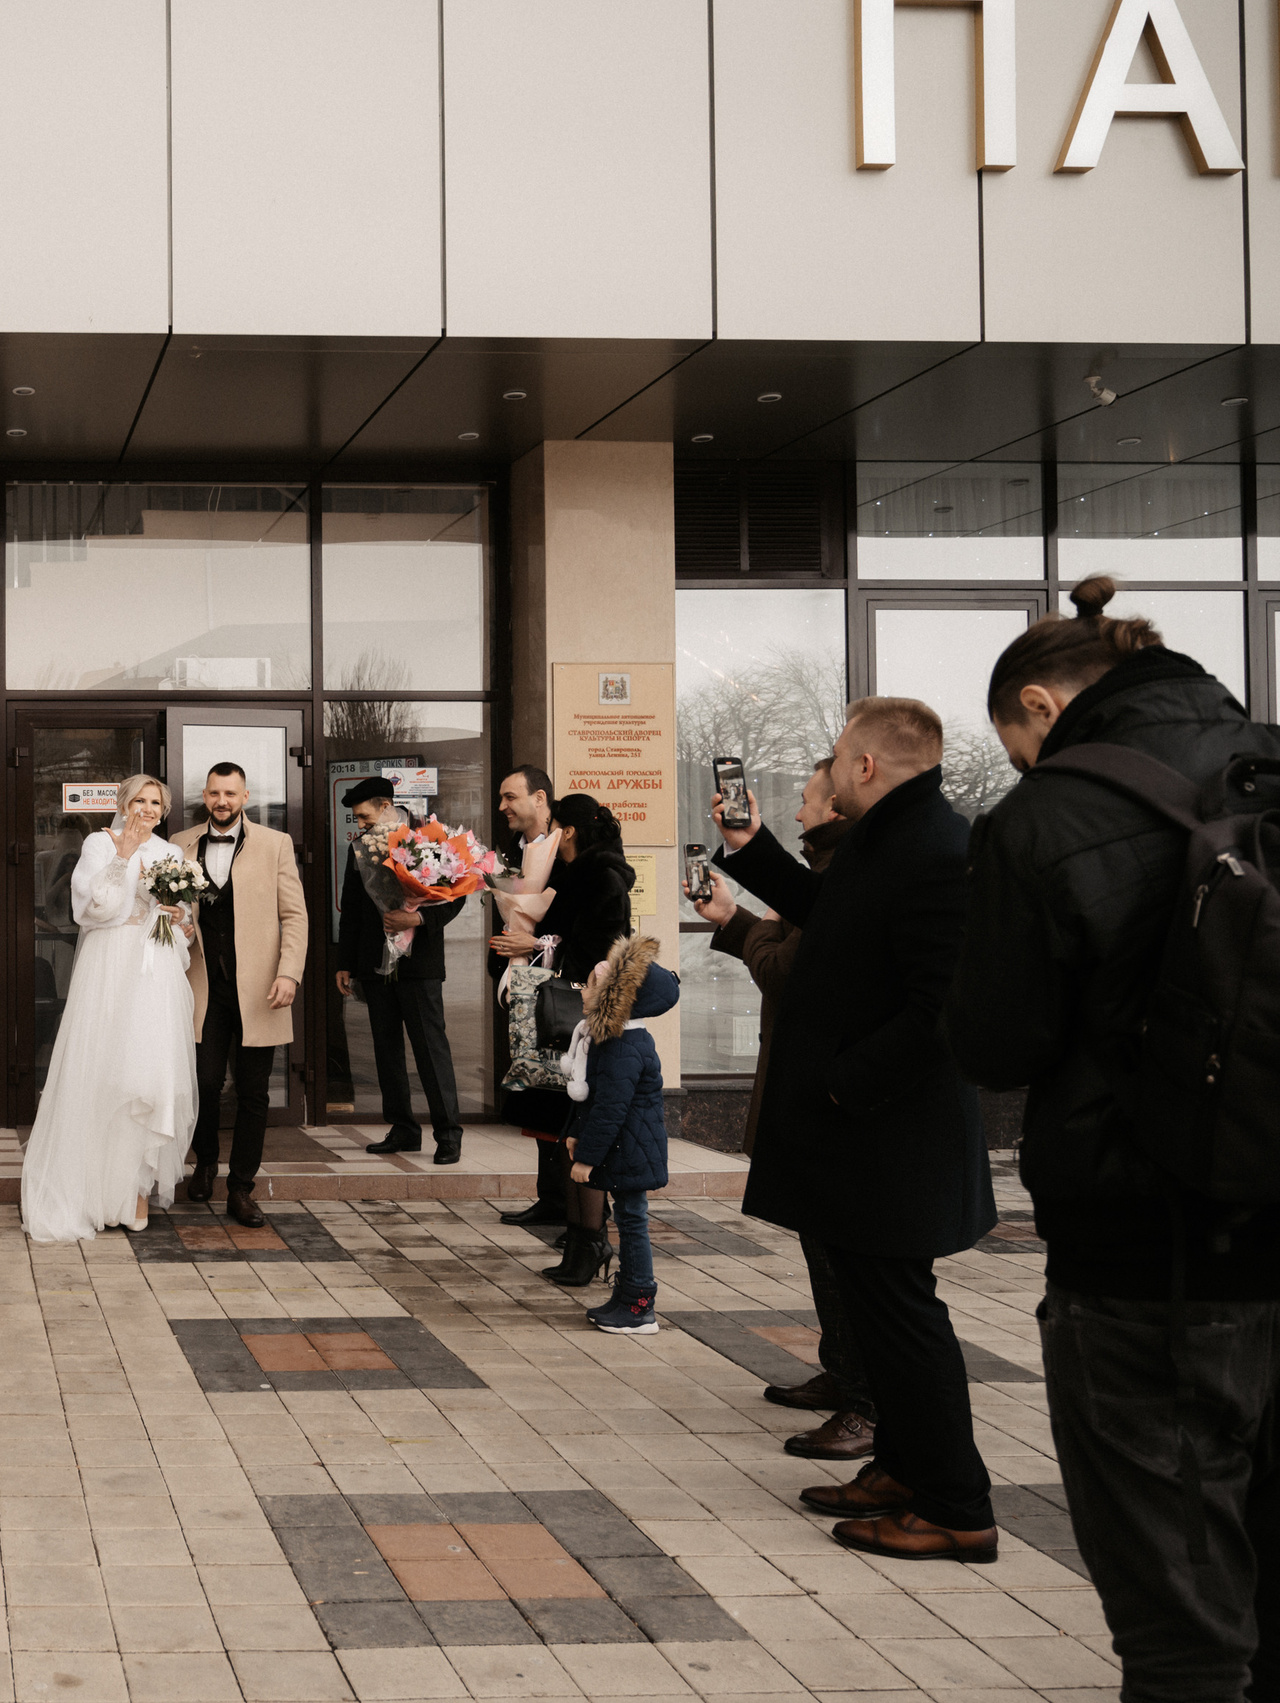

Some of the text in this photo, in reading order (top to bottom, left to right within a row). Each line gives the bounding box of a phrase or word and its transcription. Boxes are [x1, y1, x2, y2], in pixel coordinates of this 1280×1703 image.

[854, 0, 1280, 175] ПА
[330, 764, 356, 773] 20:18
[569, 779, 662, 789] ДОМ ДРУЖБЫ
[611, 800, 648, 810] работы:
